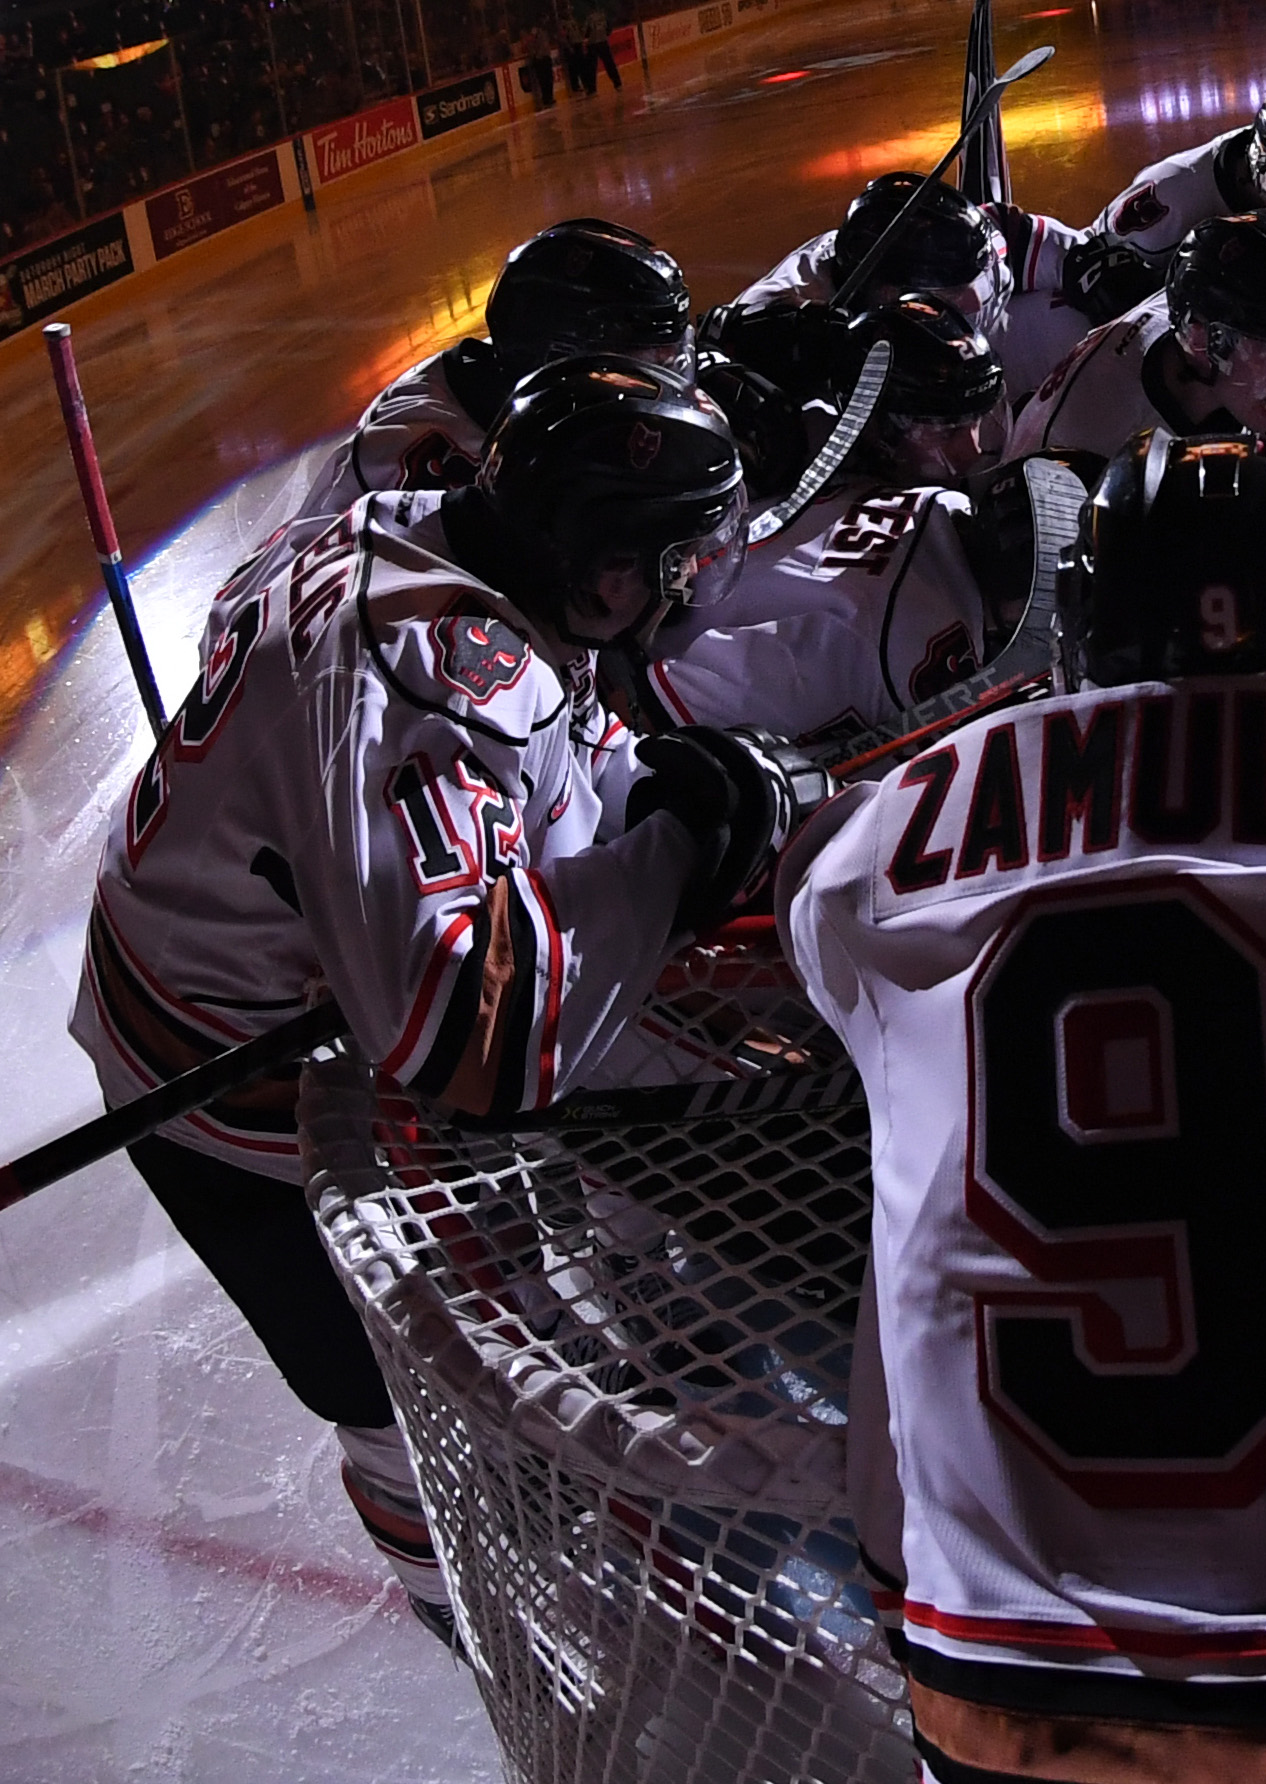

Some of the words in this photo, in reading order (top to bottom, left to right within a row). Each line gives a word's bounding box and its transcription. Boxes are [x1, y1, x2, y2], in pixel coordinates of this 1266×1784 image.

[438, 90, 485, 119] Sandman
[316, 131, 352, 177] Tim
[353, 119, 414, 164] Hortons
[23, 267, 66, 310] MARCH
[63, 252, 99, 290] PARTY
[97, 239, 126, 272] PACK
[1115, 313, 1152, 355] CCM
[1197, 582, 1241, 653] 9
